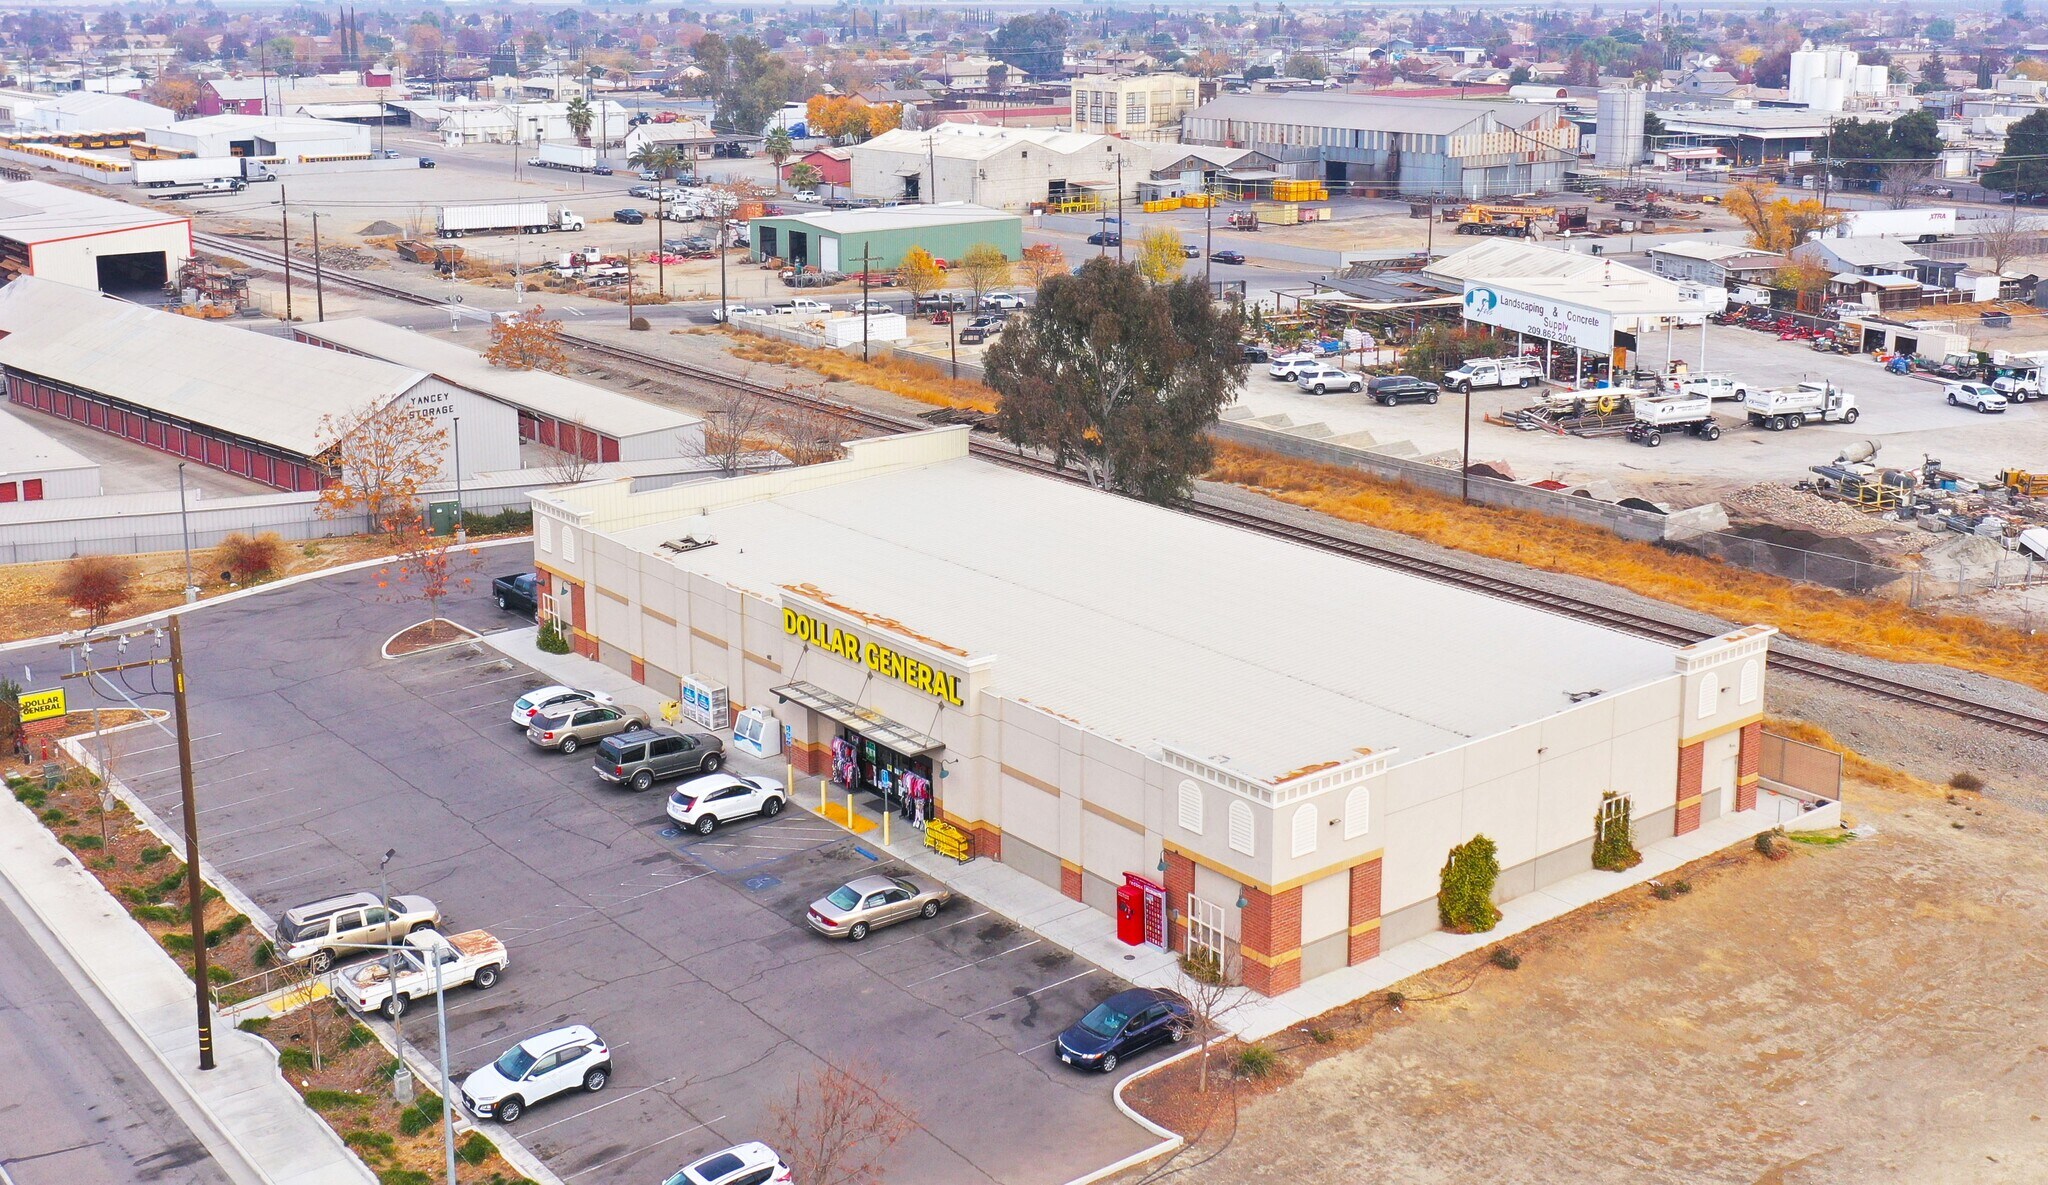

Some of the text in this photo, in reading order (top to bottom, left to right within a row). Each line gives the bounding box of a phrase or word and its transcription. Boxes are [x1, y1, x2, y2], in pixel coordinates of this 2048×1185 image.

[1929, 213, 1946, 221] XTRA
[1500, 295, 1544, 316] Landscaping
[1552, 307, 1558, 317] &
[1566, 311, 1599, 327] Concrete
[1544, 317, 1569, 332] Supply
[411, 393, 449, 405] YANCEY
[409, 405, 454, 419] STORAGE
[782, 606, 964, 707] DOLLAR GENERAL
[25, 696, 59, 708] DOLLAR
[23, 703, 62, 715] GENERAL
